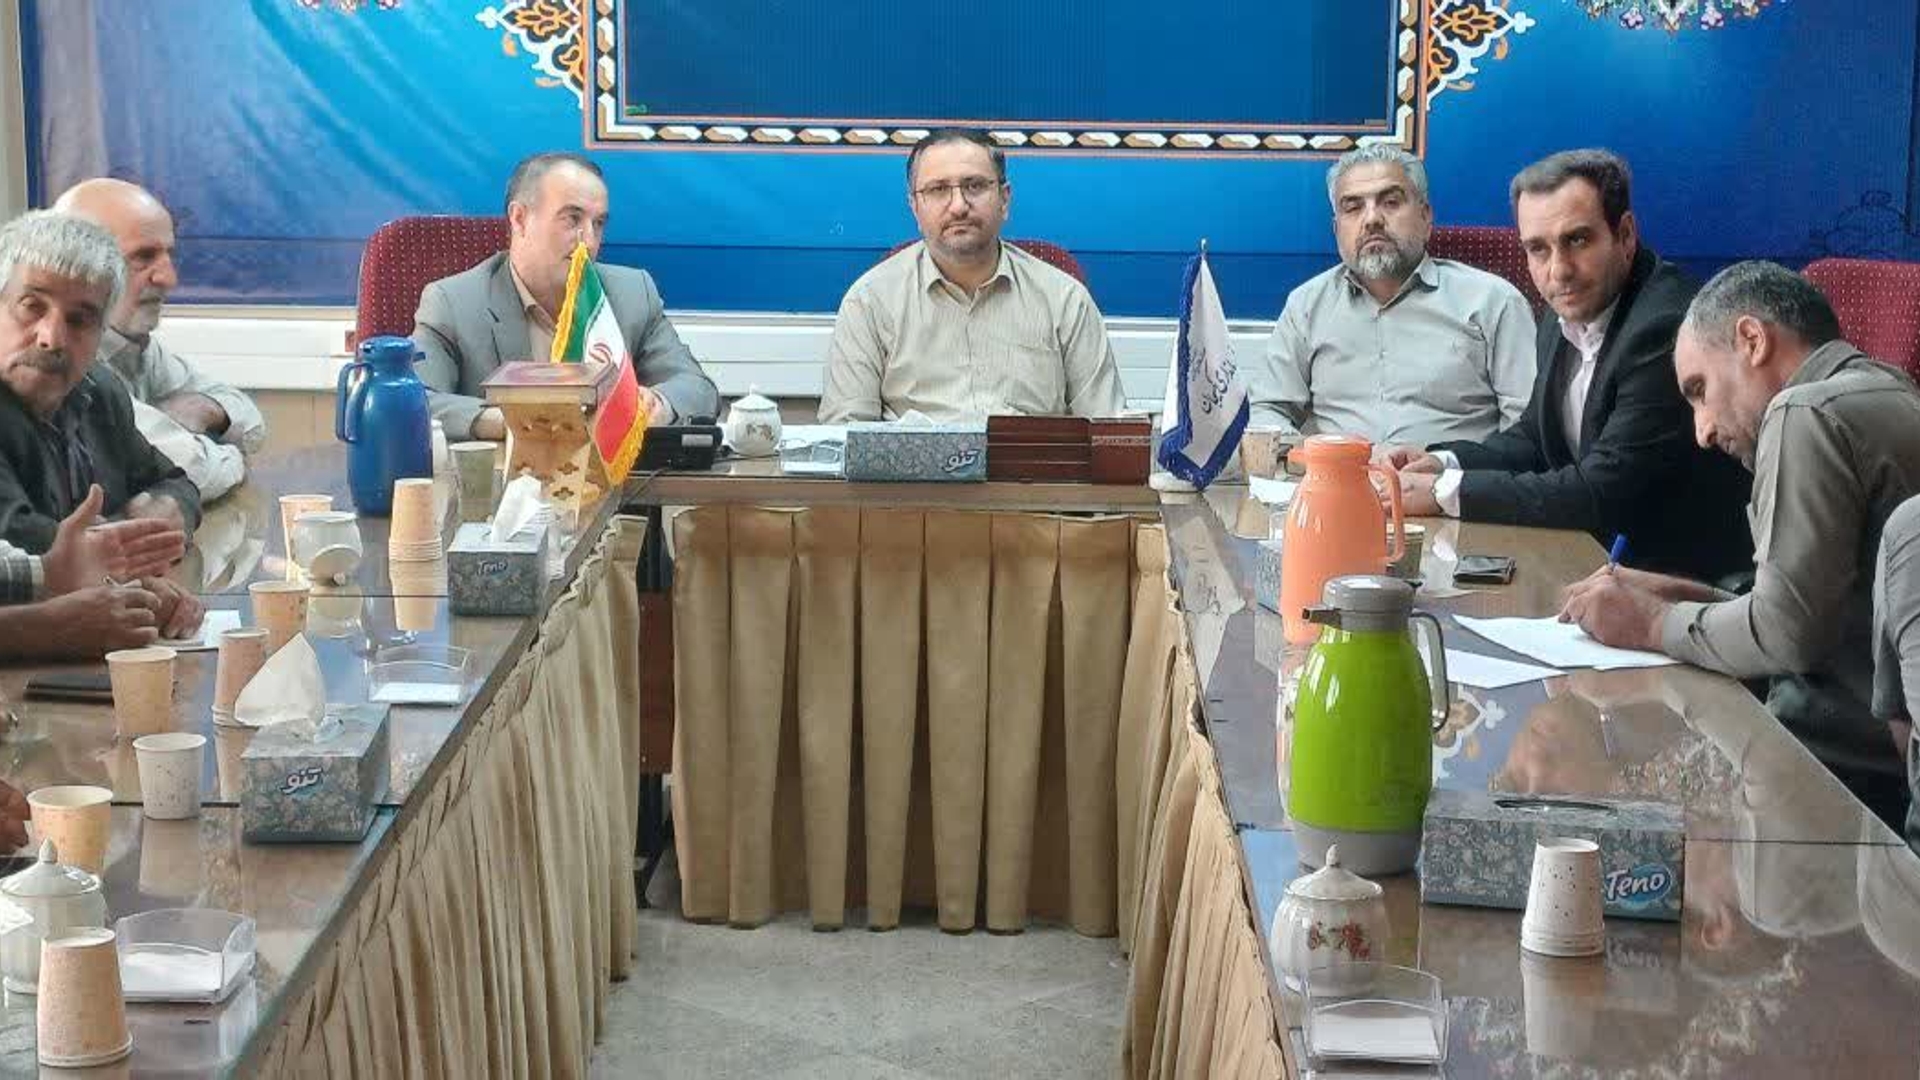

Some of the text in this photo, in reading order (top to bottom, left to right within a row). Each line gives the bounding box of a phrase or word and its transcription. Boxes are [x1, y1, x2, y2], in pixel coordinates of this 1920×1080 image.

[944, 449, 979, 472] تنو
[282, 768, 322, 794] تنو
[1605, 868, 1666, 901] Teno
